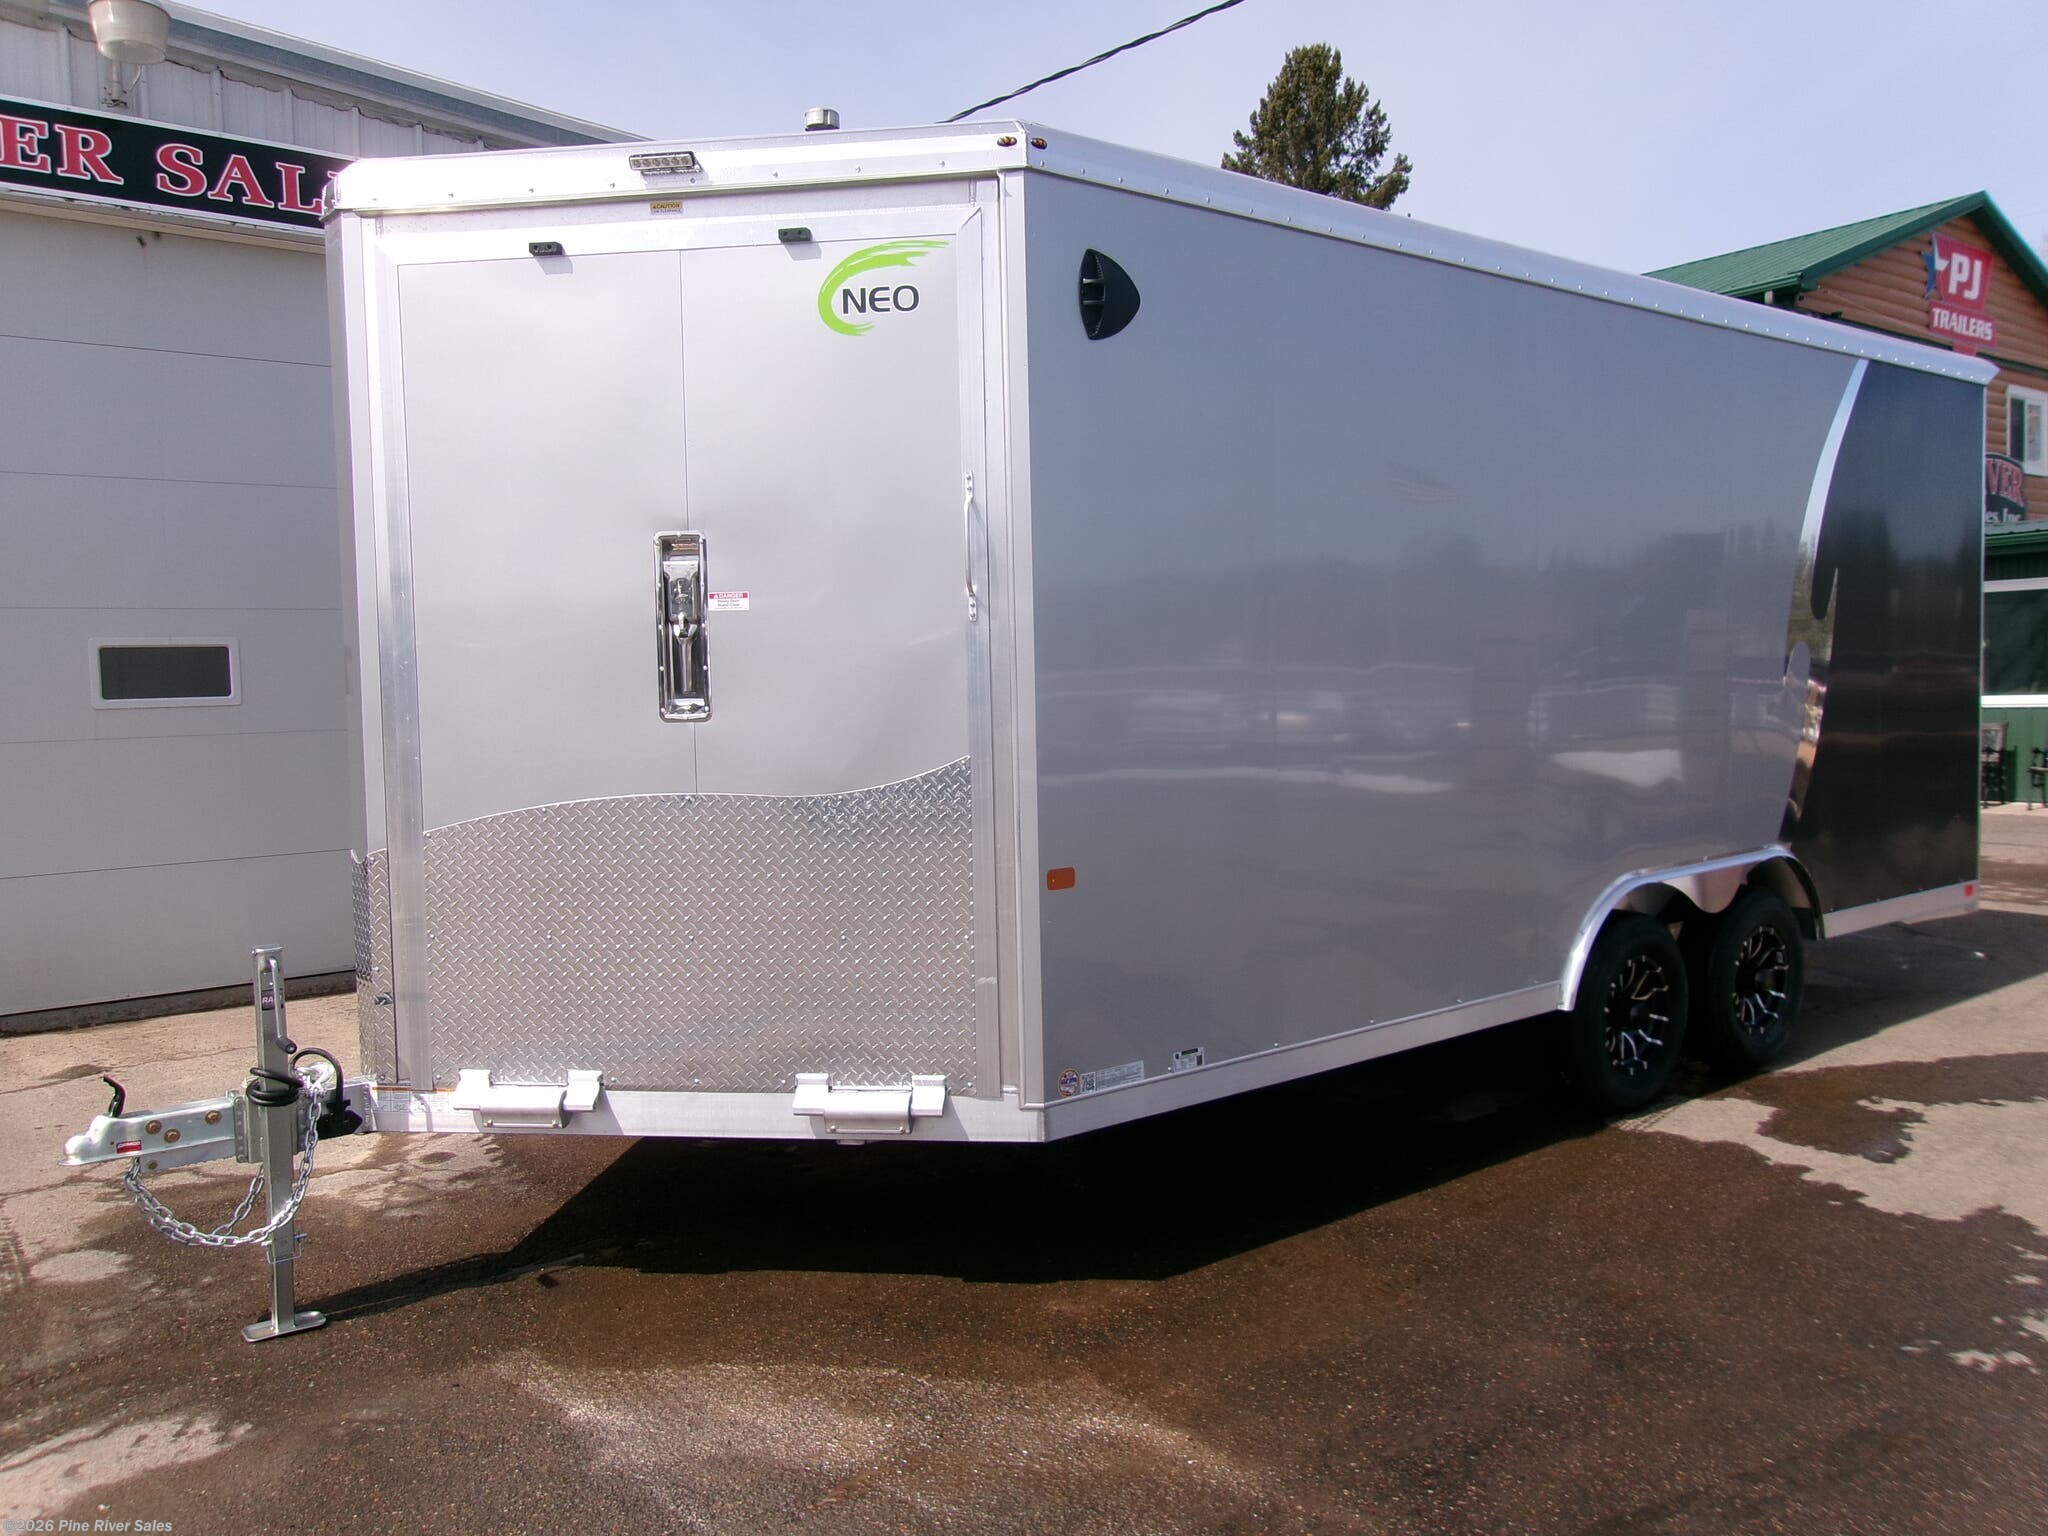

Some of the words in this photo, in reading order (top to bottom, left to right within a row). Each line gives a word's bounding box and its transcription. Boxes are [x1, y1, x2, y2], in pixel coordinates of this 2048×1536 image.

[155, 143, 340, 216] SAL
[1948, 252, 1983, 301] PJ
[842, 284, 920, 315] NEO
[1932, 307, 1993, 341] TRAILERS
